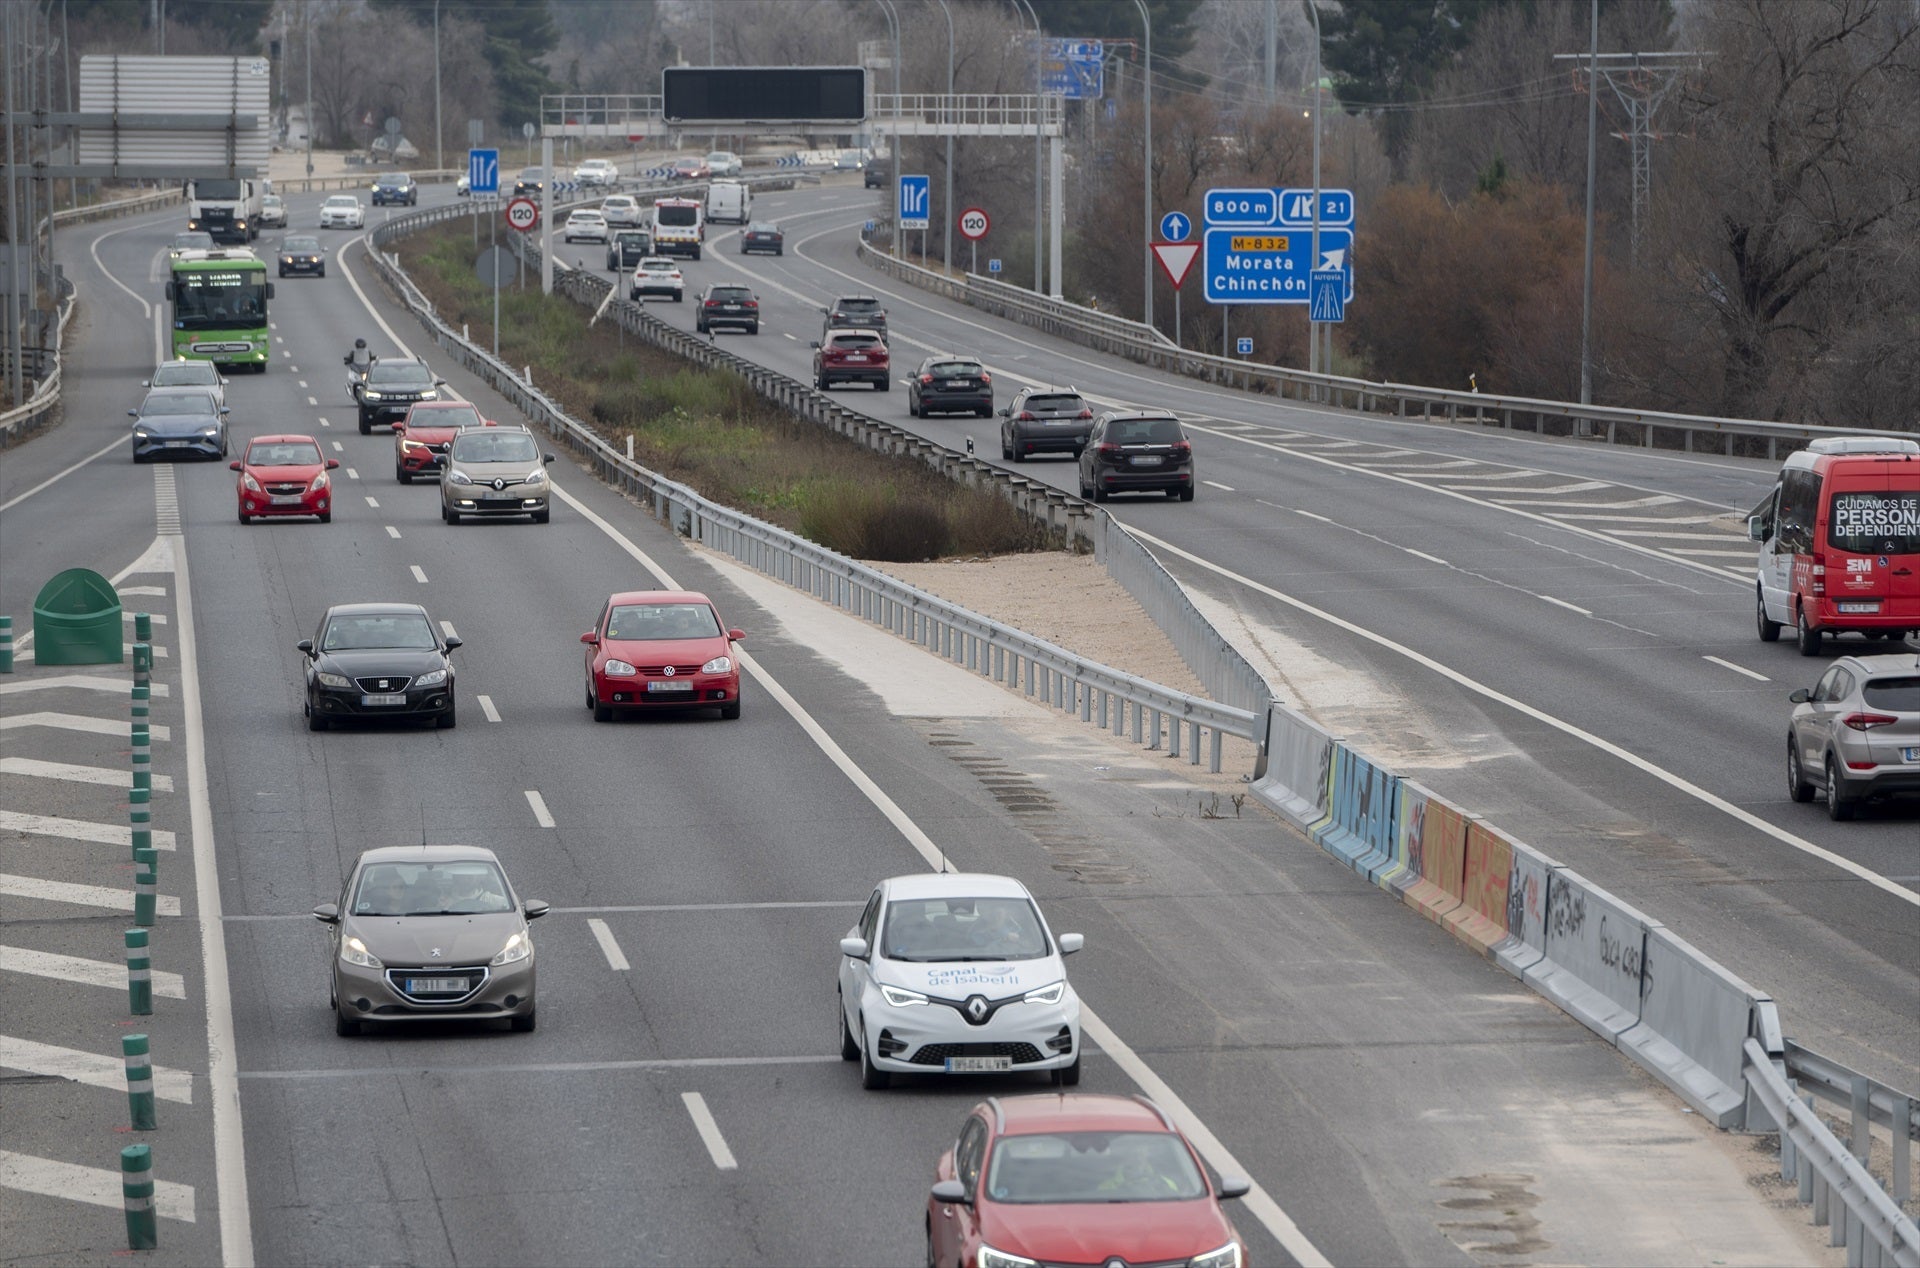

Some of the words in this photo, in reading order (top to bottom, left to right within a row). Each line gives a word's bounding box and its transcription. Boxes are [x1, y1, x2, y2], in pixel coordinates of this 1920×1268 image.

[1214, 201, 1250, 214] 800
[1254, 205, 1267, 214] m
[1326, 201, 1344, 214] 21
[511, 208, 533, 220] 120
[964, 217, 985, 229] 120
[1233, 238, 1287, 250] M-832
[1226, 255, 1294, 270] Morata
[1214, 275, 1306, 290] Chinchón
[1836, 499, 1899, 510] CUIDAMOS
[1901, 499, 1918, 510] DE
[1836, 509, 1920, 525] PERSON
[927, 967, 977, 977] Canal
[928, 976, 951, 987] de
[954, 975, 1005, 985] Isabel
